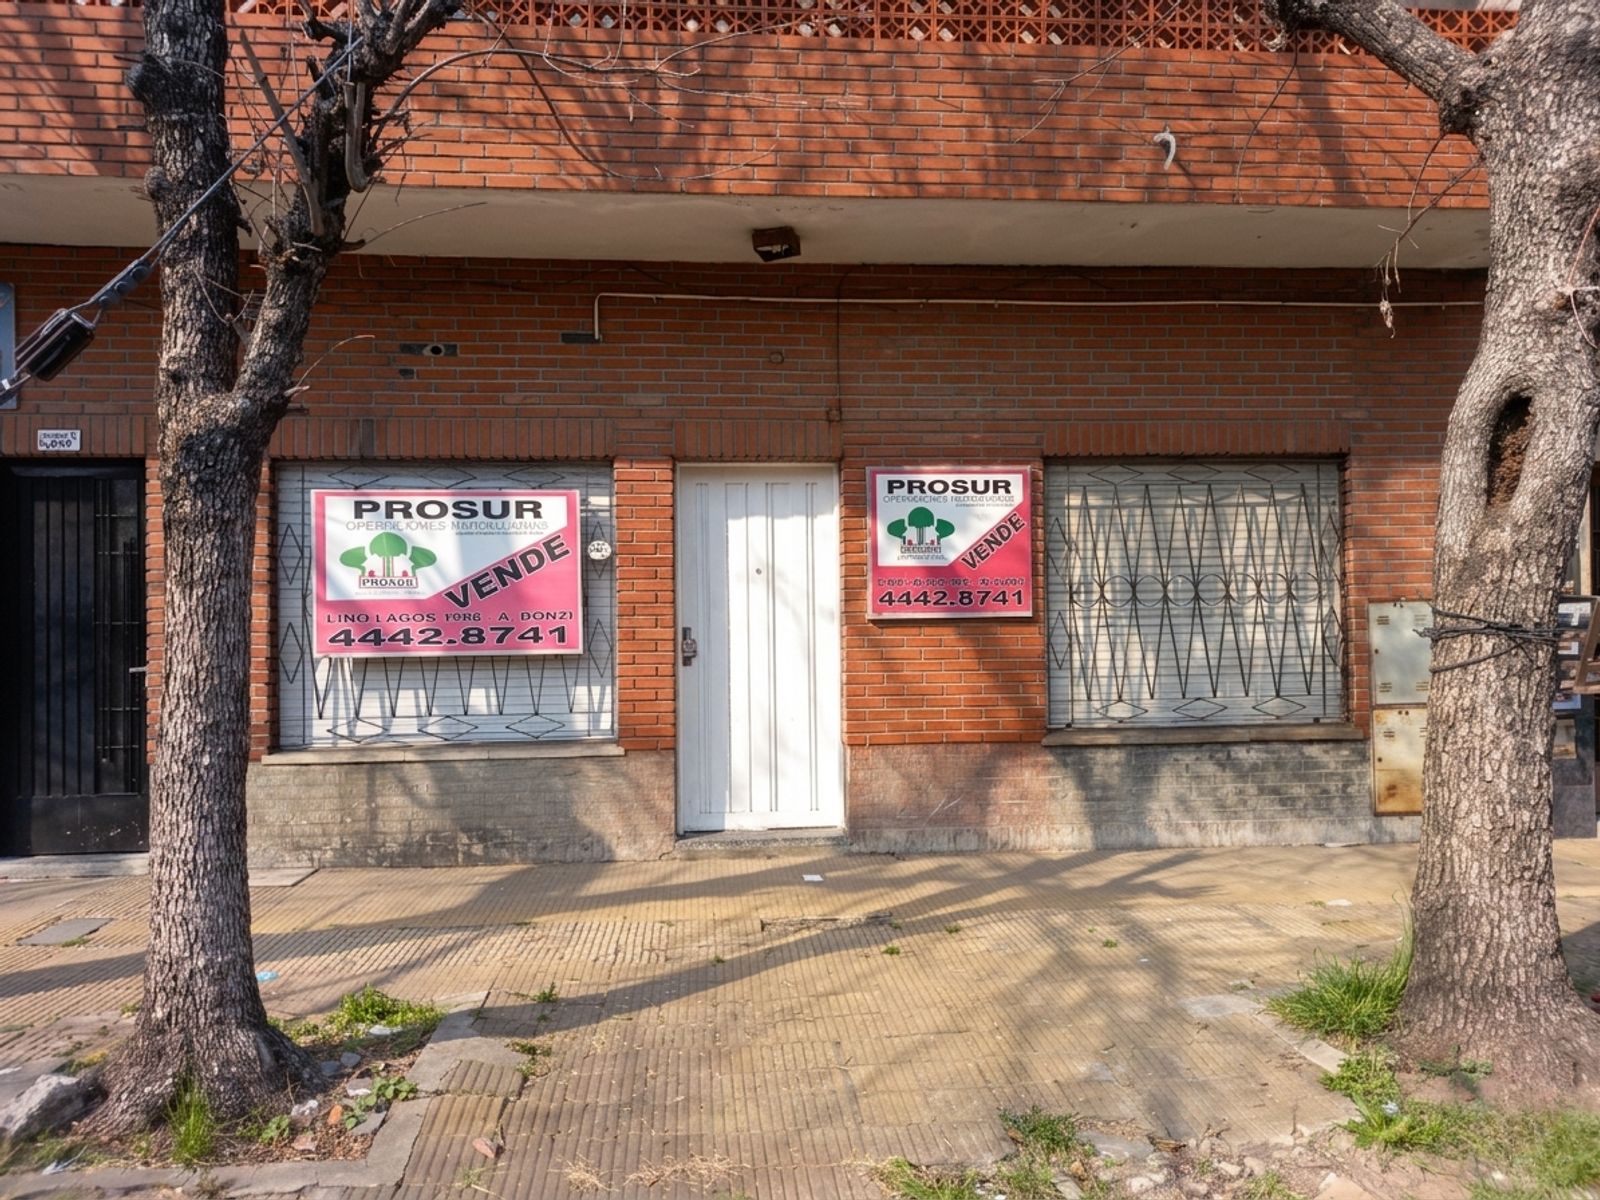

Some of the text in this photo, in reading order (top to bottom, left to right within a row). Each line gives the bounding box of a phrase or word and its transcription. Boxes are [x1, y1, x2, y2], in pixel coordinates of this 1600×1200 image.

[887, 480, 1011, 494] PROSUR
[354, 500, 542, 519] PROSUR
[961, 513, 1025, 568] VENDE
[444, 535, 570, 608] VENDE
[879, 590, 1023, 606] 4442.8741
[327, 613, 369, 623] LINO
[328, 626, 566, 646] 4442.8741
